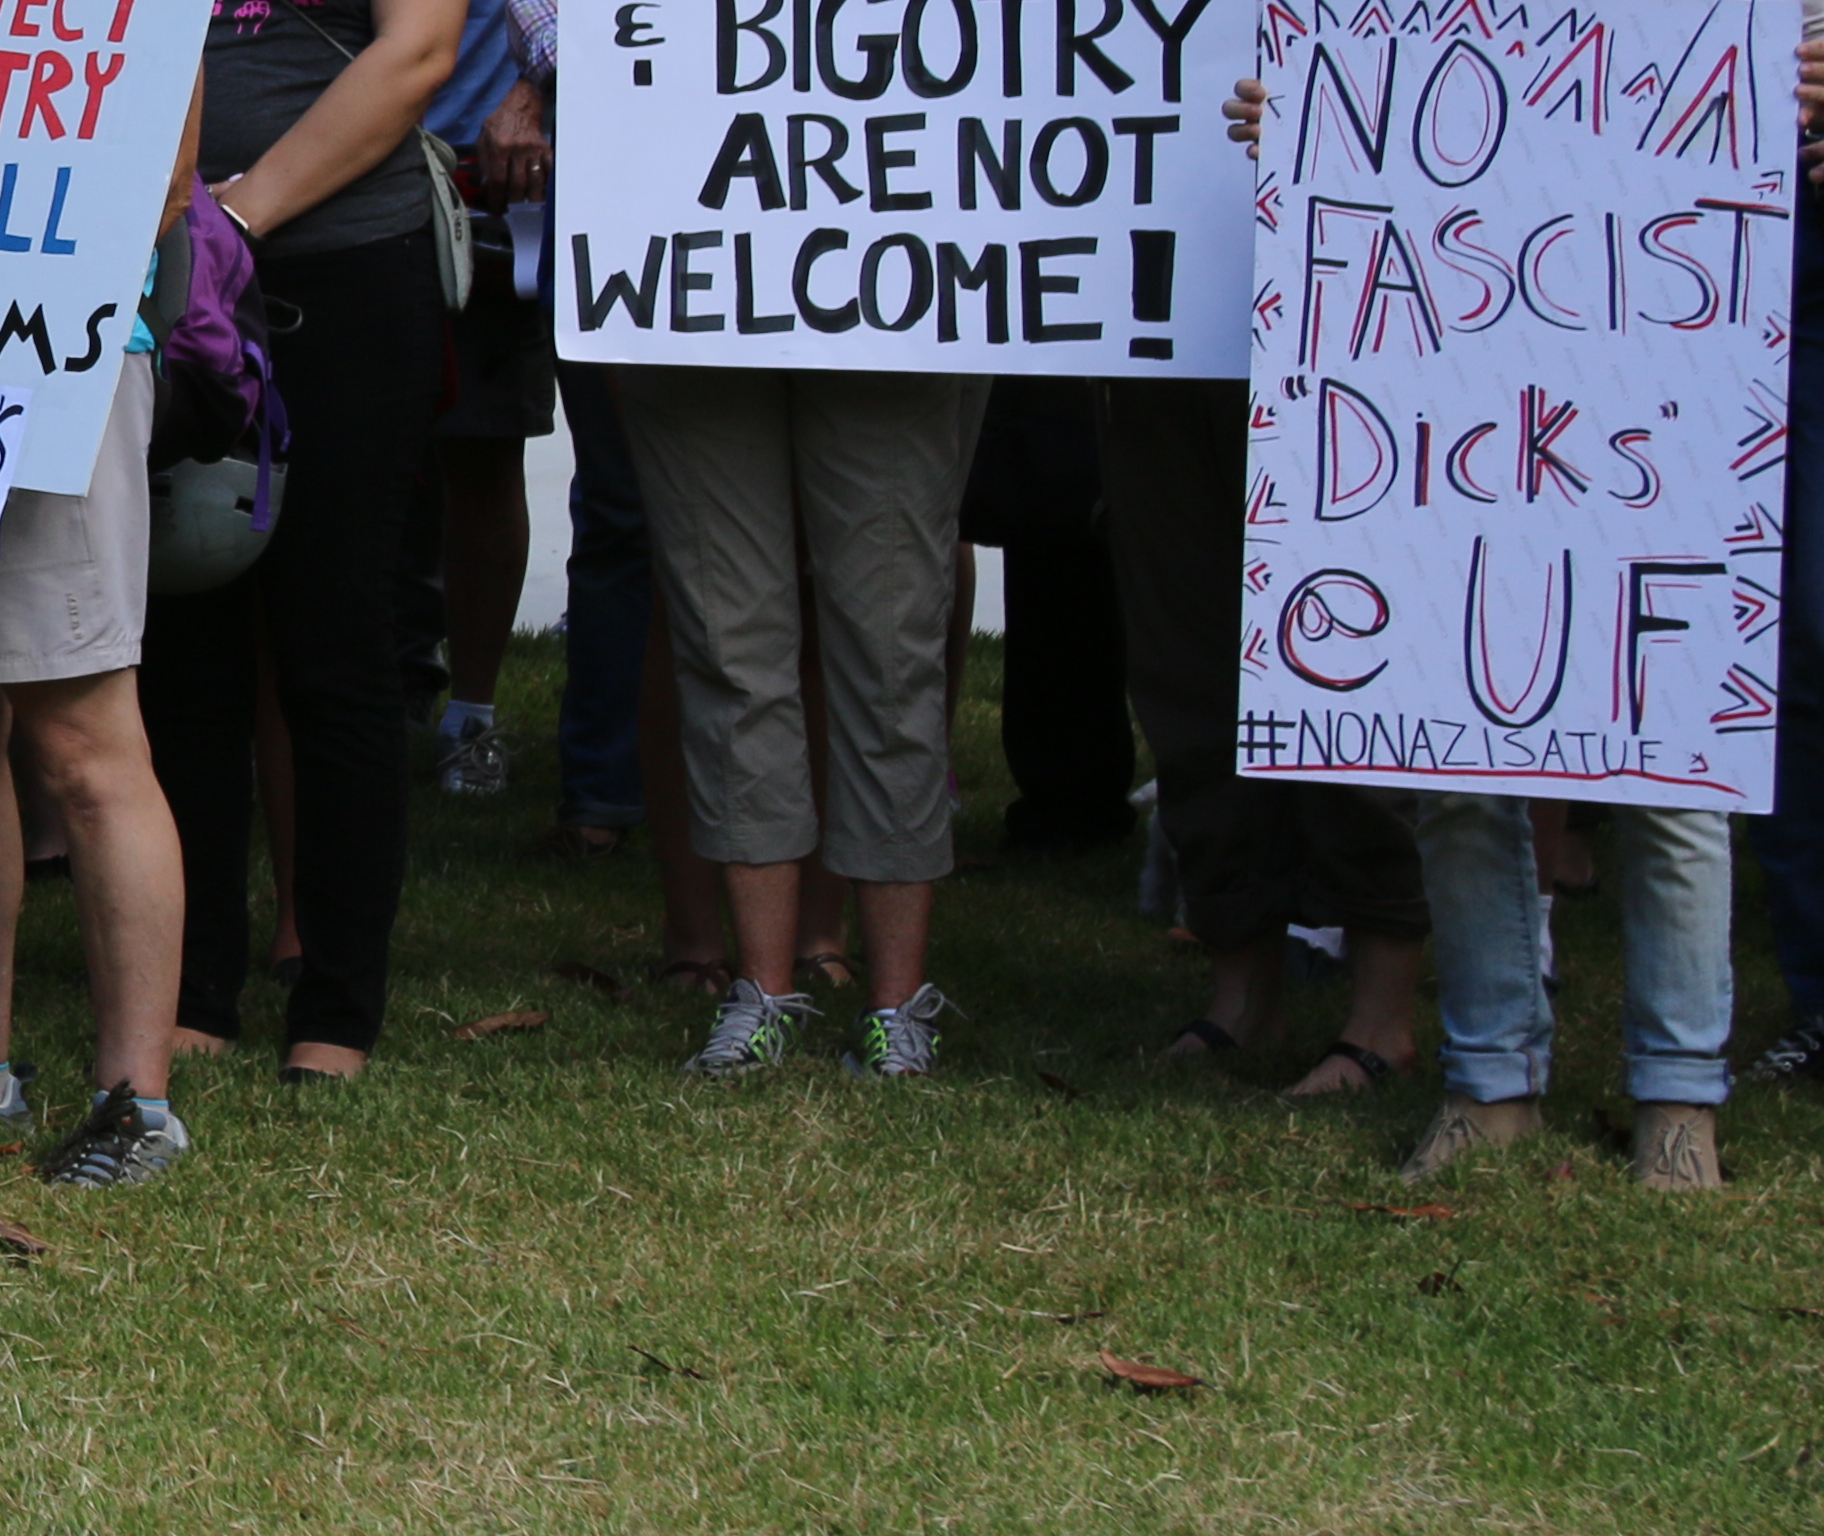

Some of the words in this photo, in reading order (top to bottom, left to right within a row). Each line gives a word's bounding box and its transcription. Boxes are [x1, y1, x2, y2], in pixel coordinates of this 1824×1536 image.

[697, 112, 933, 213] ARE
[957, 114, 1181, 212] NOT
[1293, 37, 1509, 188] NO
[570, 226, 1176, 361] WELCOME!
[1298, 195, 1790, 373] FASCIST
[1463, 534, 1727, 735] UF
[1238, 709, 1662, 777] #NONAZISATUF
